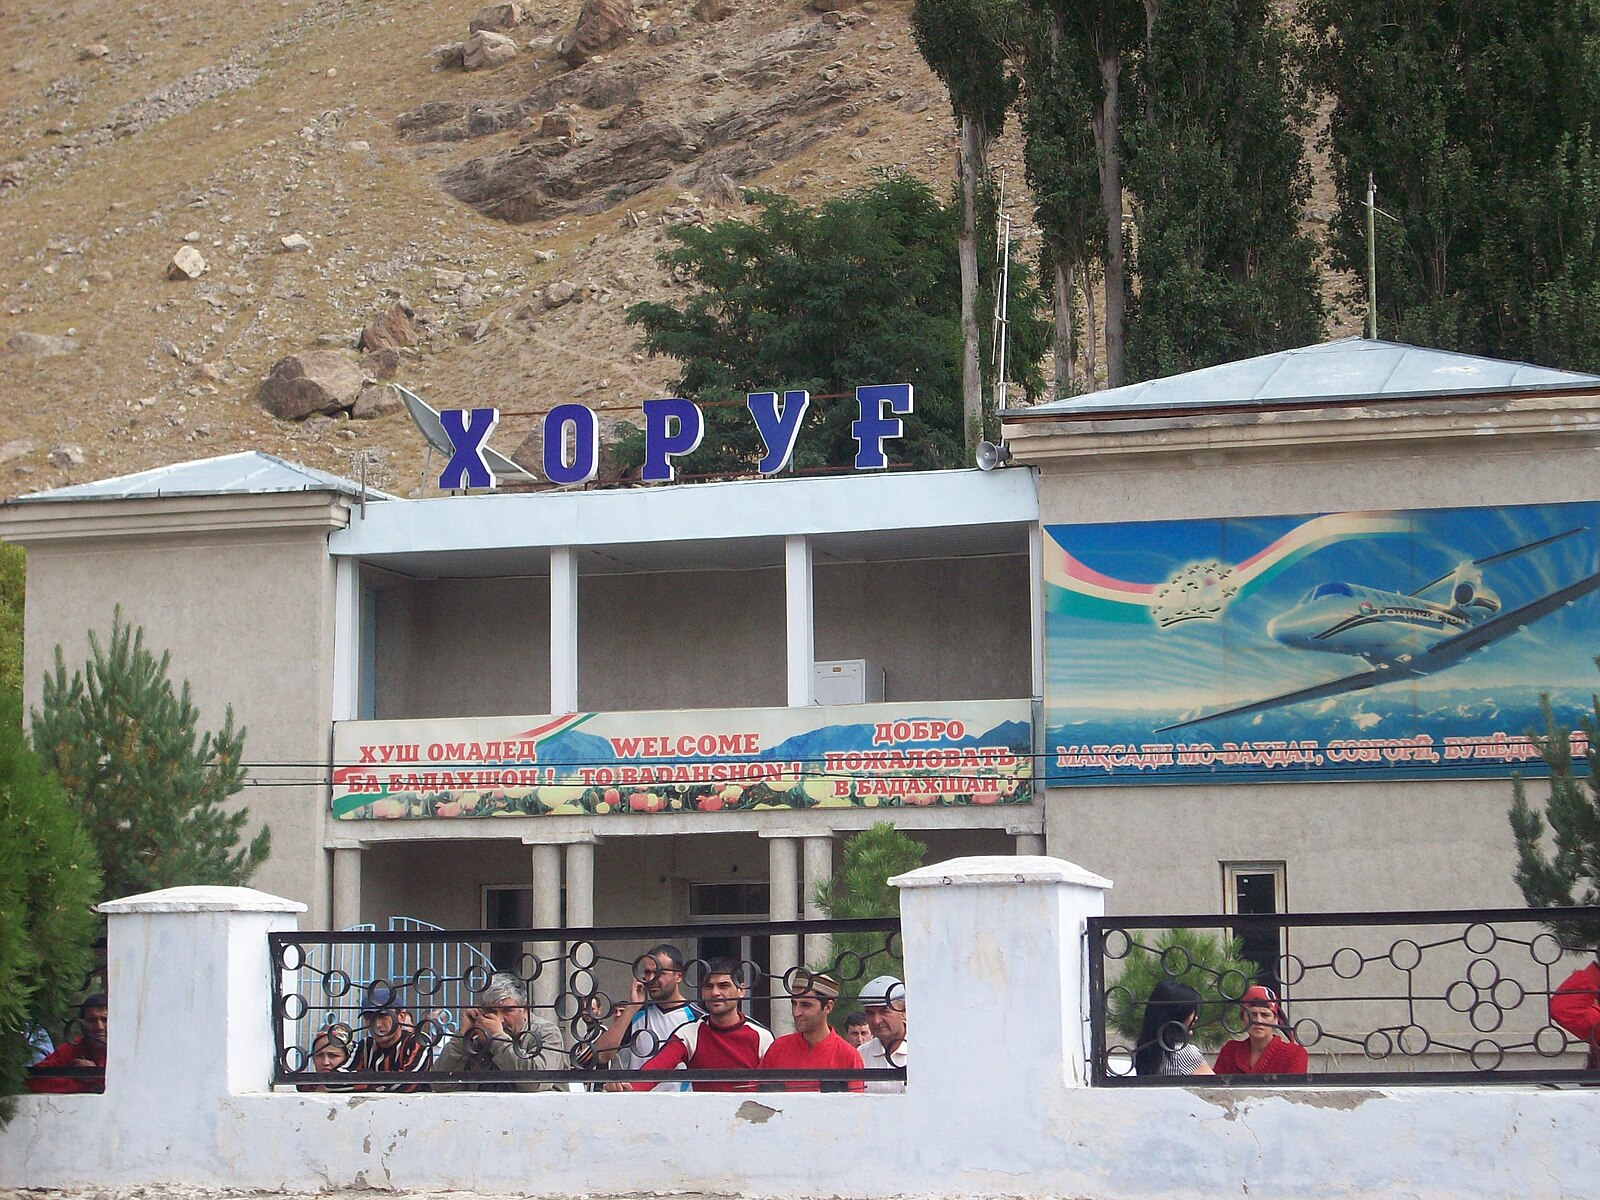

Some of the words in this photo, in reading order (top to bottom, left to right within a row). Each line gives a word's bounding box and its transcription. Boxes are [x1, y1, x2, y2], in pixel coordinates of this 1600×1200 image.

[874, 721, 964, 744] ДОБРО
[358, 743, 420, 764] ХУШ
[427, 740, 536, 763] ОМАДЕД
[610, 733, 760, 757] WELCOME
[825, 747, 1016, 771] ПОЖАЛОВАТЬ
[347, 774, 381, 793] БА
[579, 768, 613, 786] TO
[834, 780, 849, 796] В
